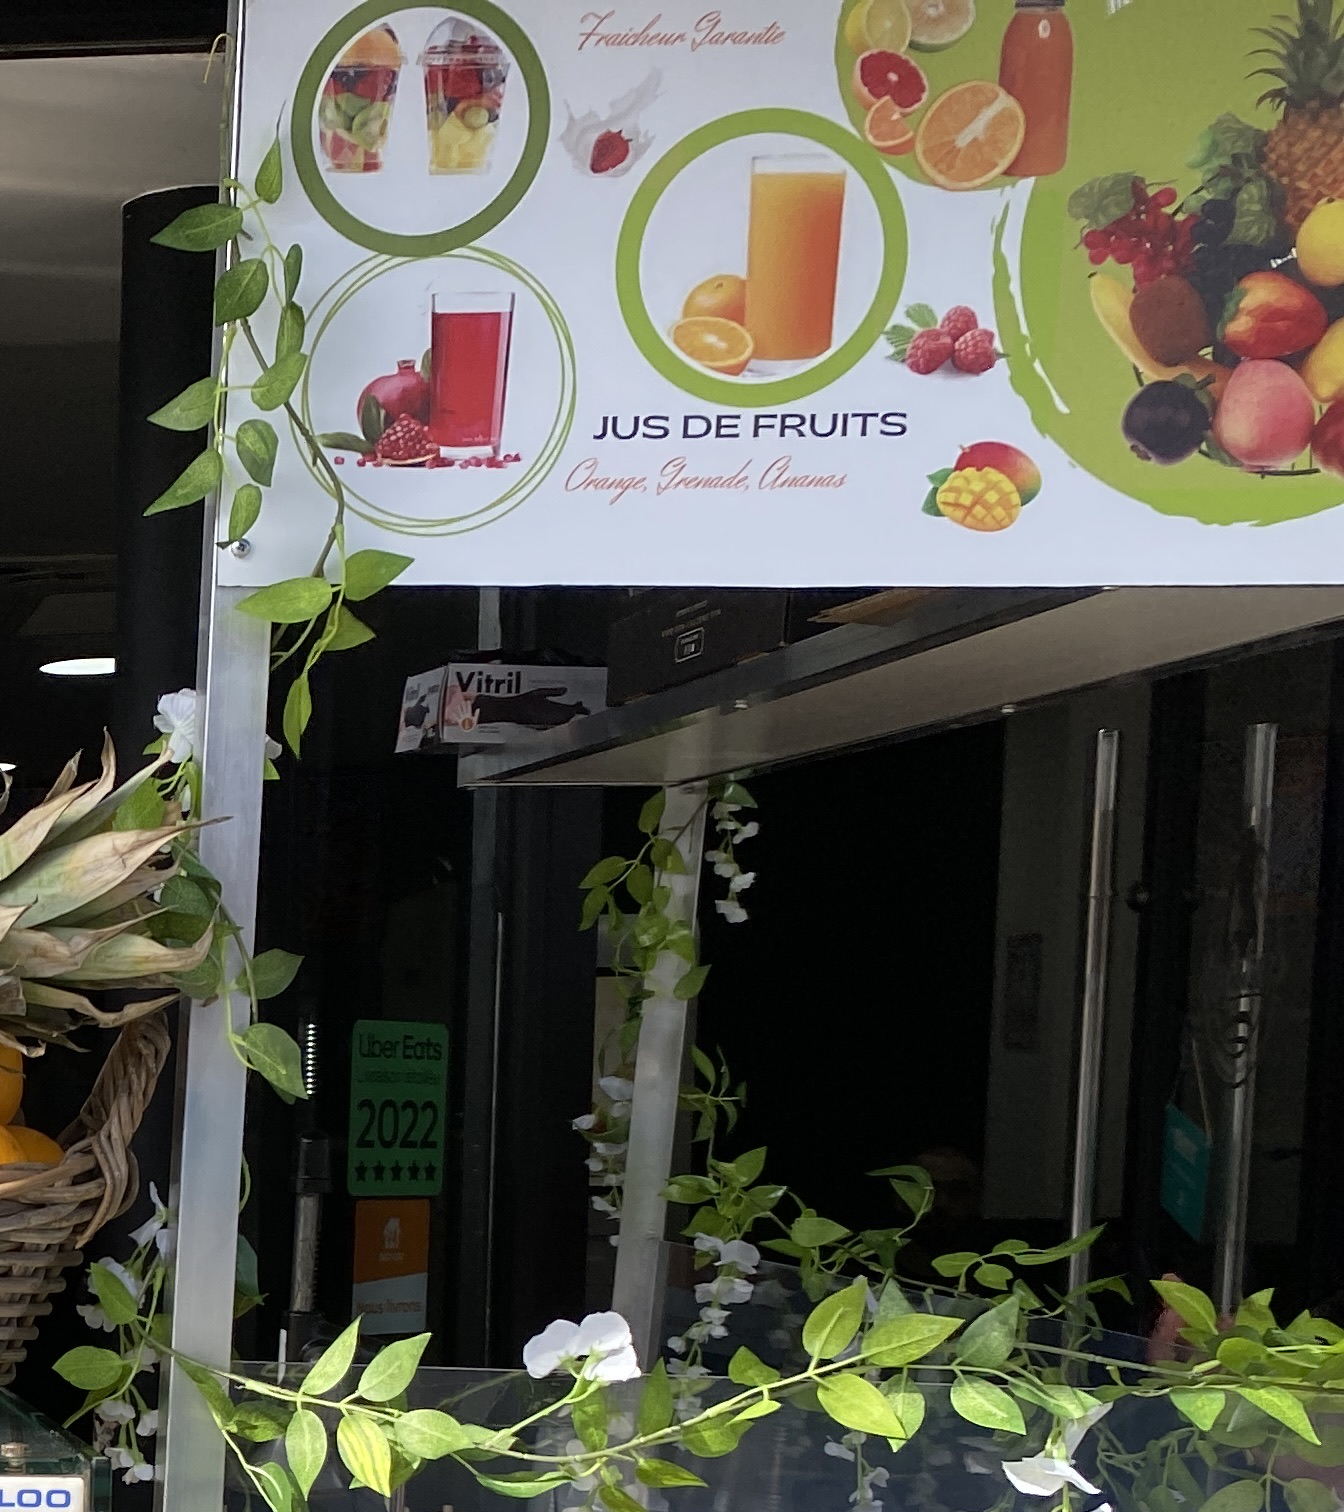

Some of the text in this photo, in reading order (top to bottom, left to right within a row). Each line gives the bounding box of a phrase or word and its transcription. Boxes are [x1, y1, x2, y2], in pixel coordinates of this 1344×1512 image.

[691, 10, 787, 52] Garantie
[592, 412, 908, 441] JUS DE FRUITS
[564, 455, 848, 506] Orange, Grenade, Ananas
[456, 671, 522, 694] Vitril
[359, 1032, 442, 1061] Uber Eats
[355, 1098, 440, 1151] 2022
